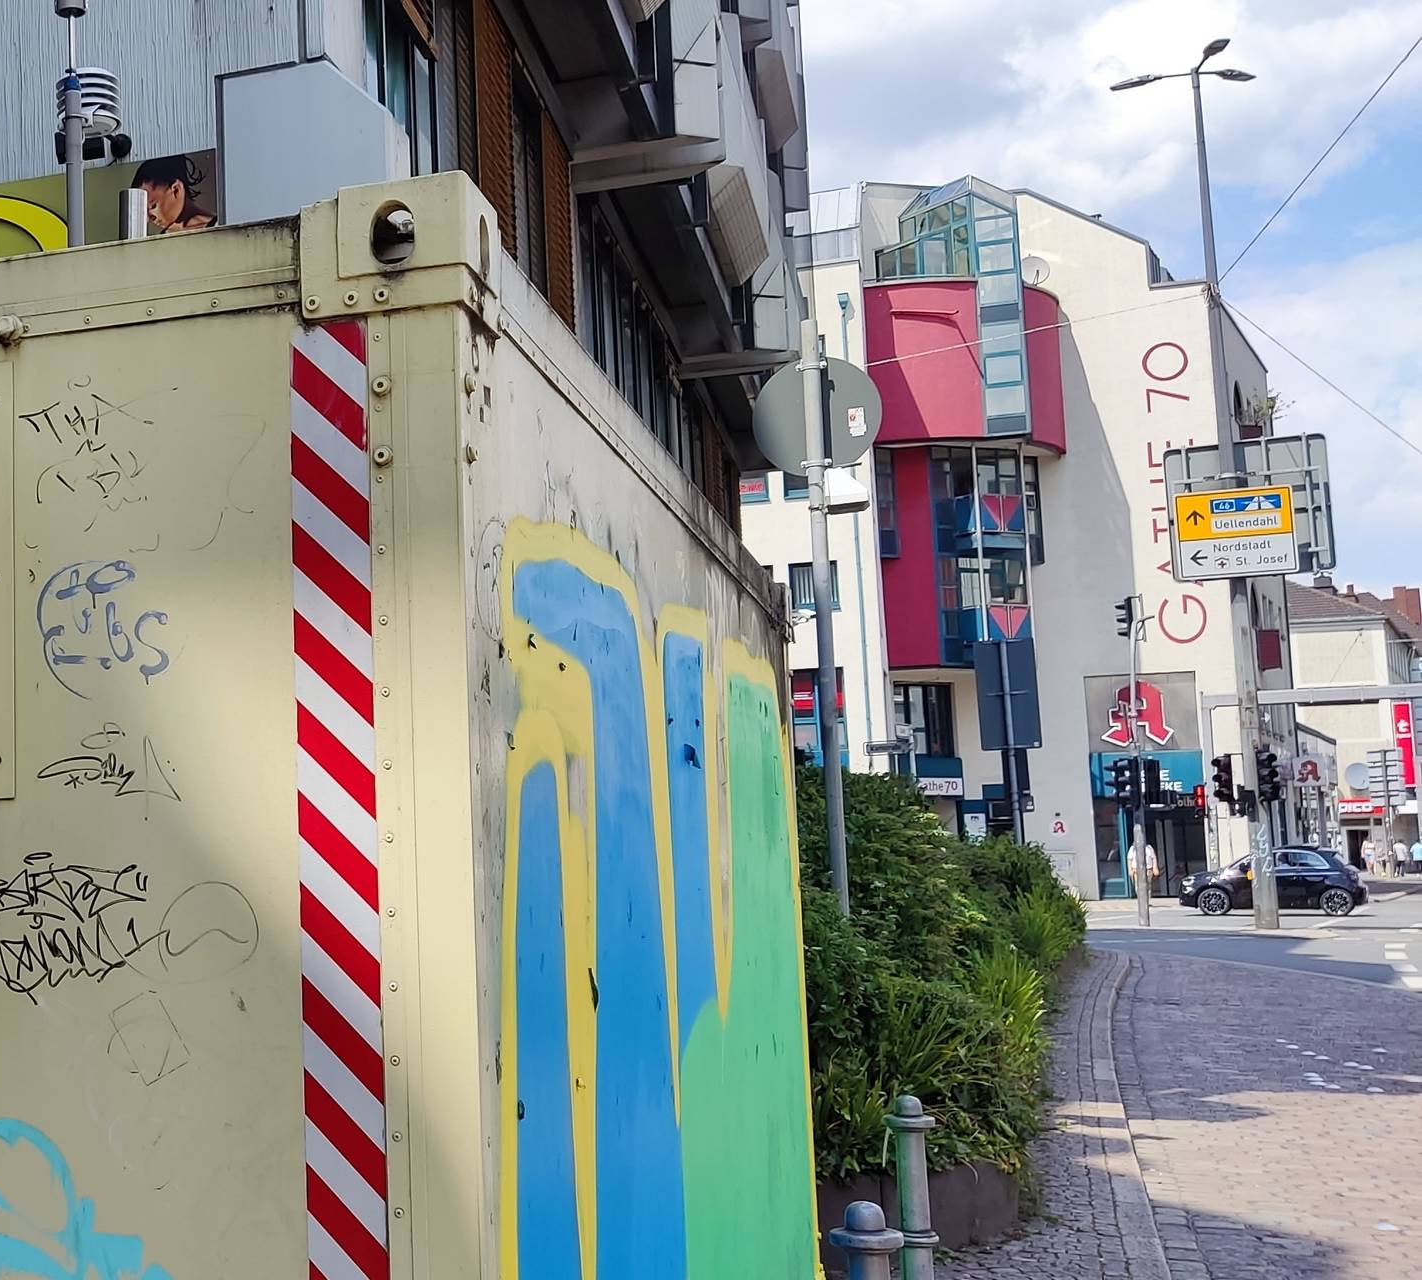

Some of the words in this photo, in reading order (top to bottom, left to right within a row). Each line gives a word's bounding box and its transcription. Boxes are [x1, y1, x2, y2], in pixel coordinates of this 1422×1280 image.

[1142, 342, 1190, 413] 70
[1214, 516, 1278, 529] Uellendahl
[1213, 540, 1272, 552] Nordstadt
[1235, 556, 1251, 566] St.
[1257, 554, 1288, 565] Josef
